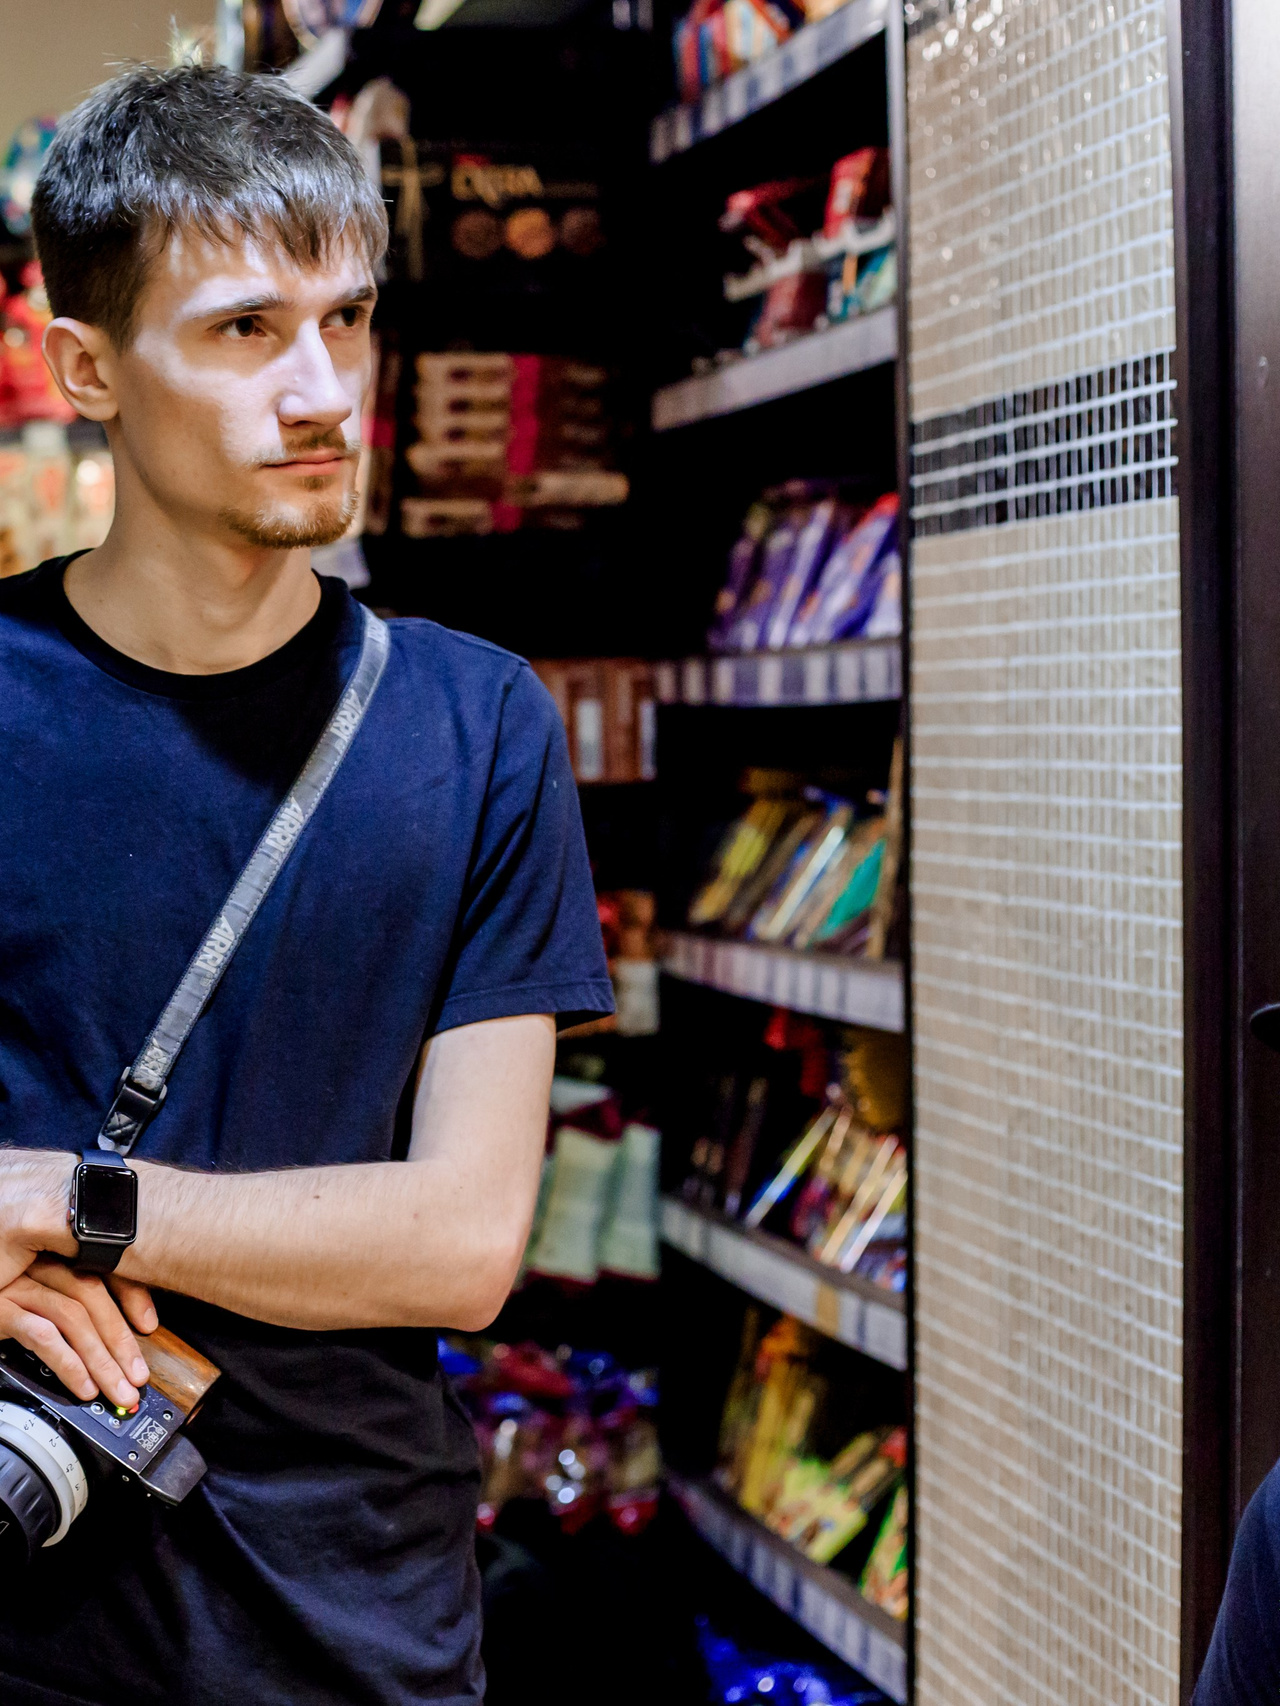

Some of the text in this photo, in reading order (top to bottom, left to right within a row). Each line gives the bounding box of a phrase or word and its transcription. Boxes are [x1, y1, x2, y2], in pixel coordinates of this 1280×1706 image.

[330, 687, 362, 743] ARRI
[265, 796, 304, 852] ARRI
[195, 915, 236, 974] ARRI
[48, 1438, 57, 1448] 2
